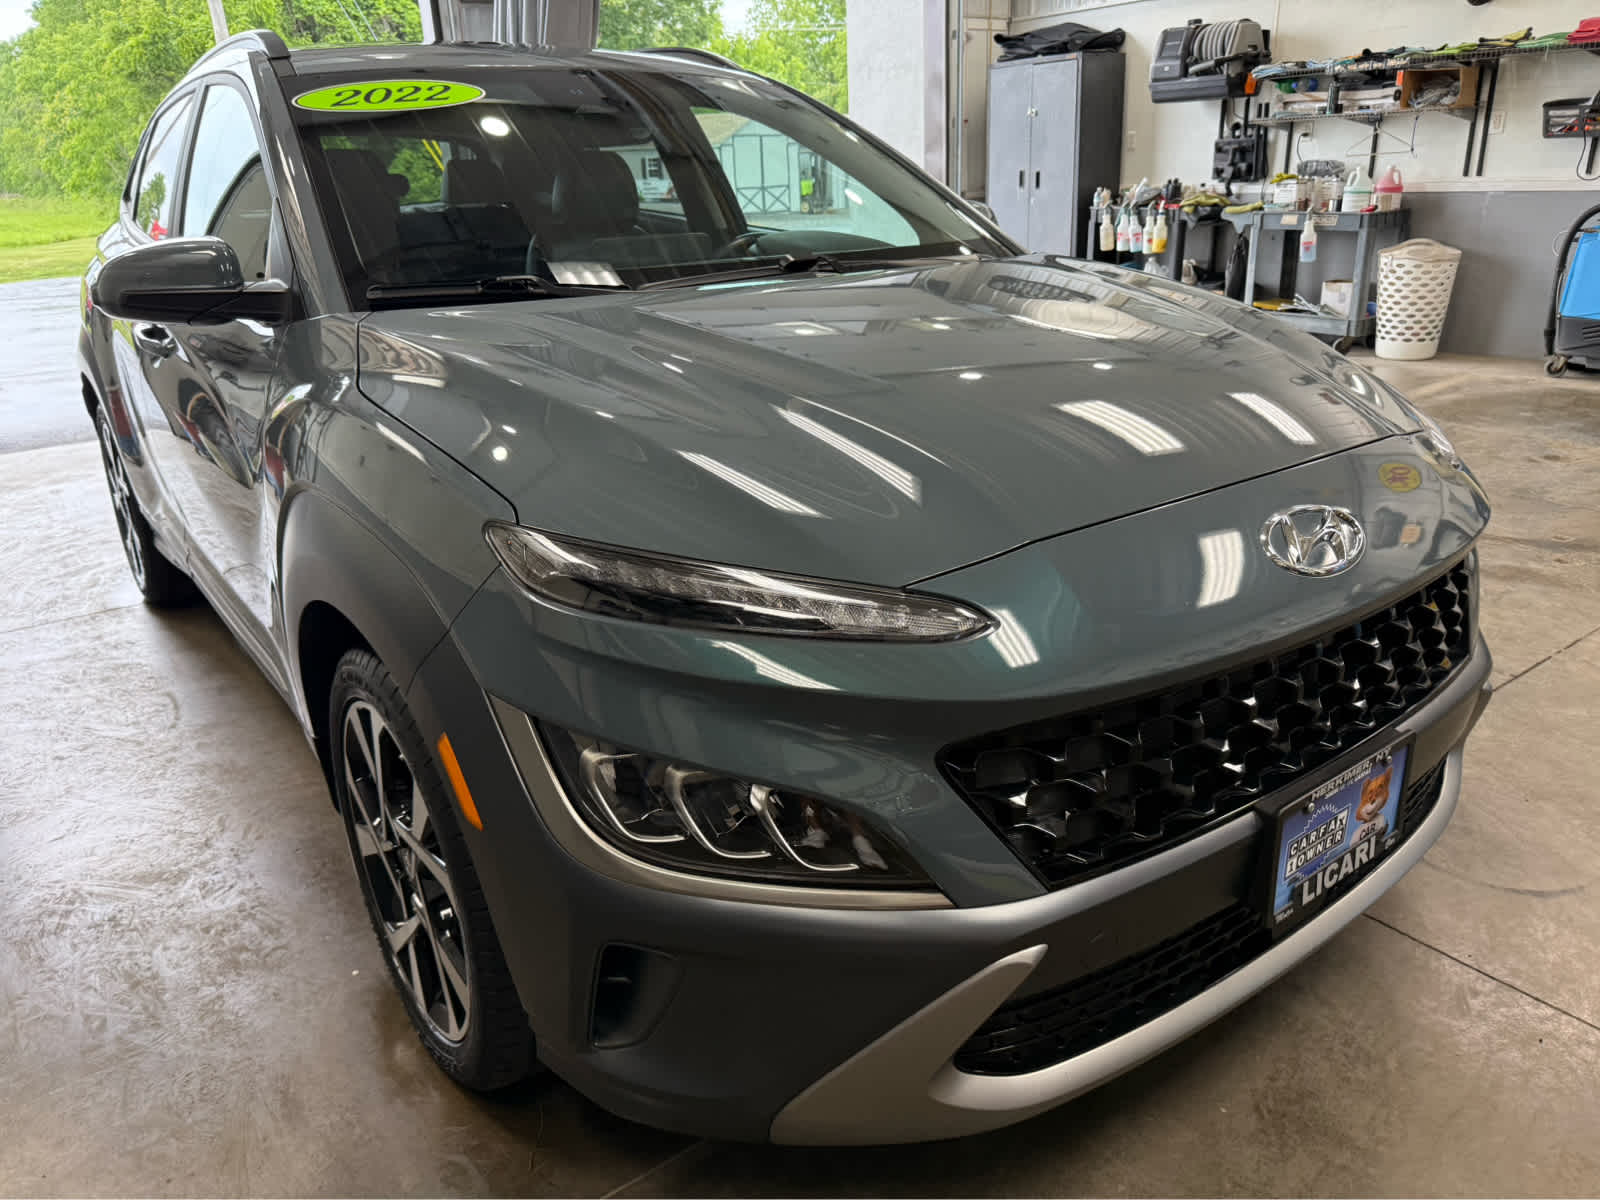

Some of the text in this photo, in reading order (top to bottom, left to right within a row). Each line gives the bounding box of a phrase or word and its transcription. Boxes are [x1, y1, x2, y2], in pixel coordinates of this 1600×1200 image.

[311, 84, 452, 108] 2022
[1290, 809, 1348, 856] CARFAX
[1298, 830, 1343, 867] OWNER
[1302, 835, 1376, 906] LICARI
